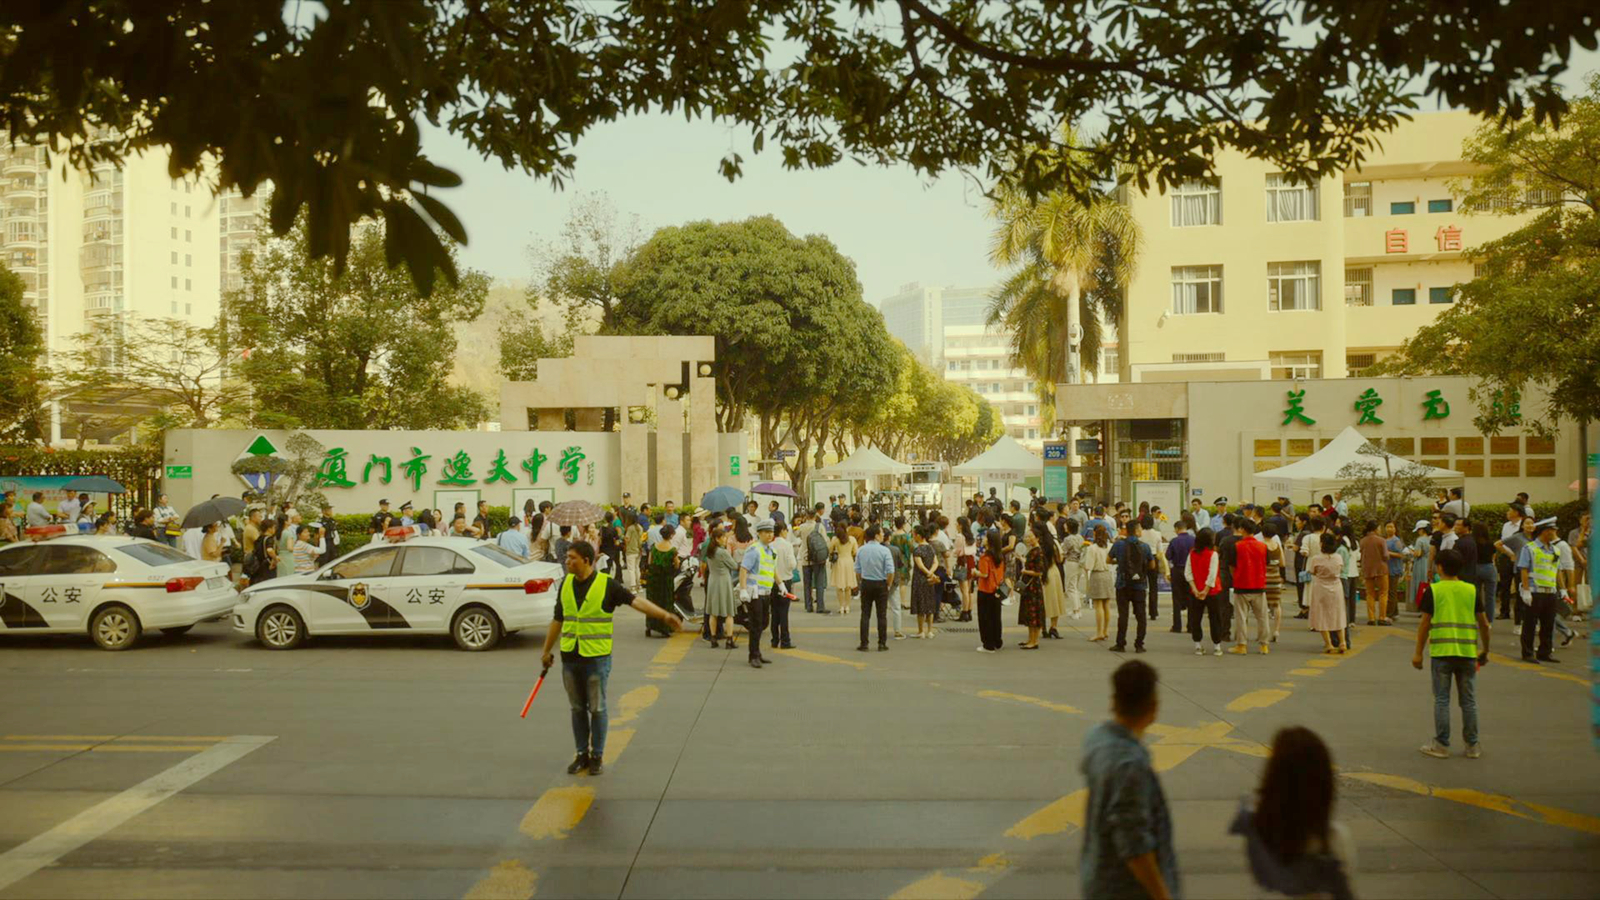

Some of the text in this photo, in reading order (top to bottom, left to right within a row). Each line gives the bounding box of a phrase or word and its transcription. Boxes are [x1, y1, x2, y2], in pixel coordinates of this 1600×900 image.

[1385, 225, 1461, 253] 自信
[309, 446, 586, 492] 厦门市逸夫中学
[41, 587, 82, 603] 公安
[406, 588, 445, 605] 公安
